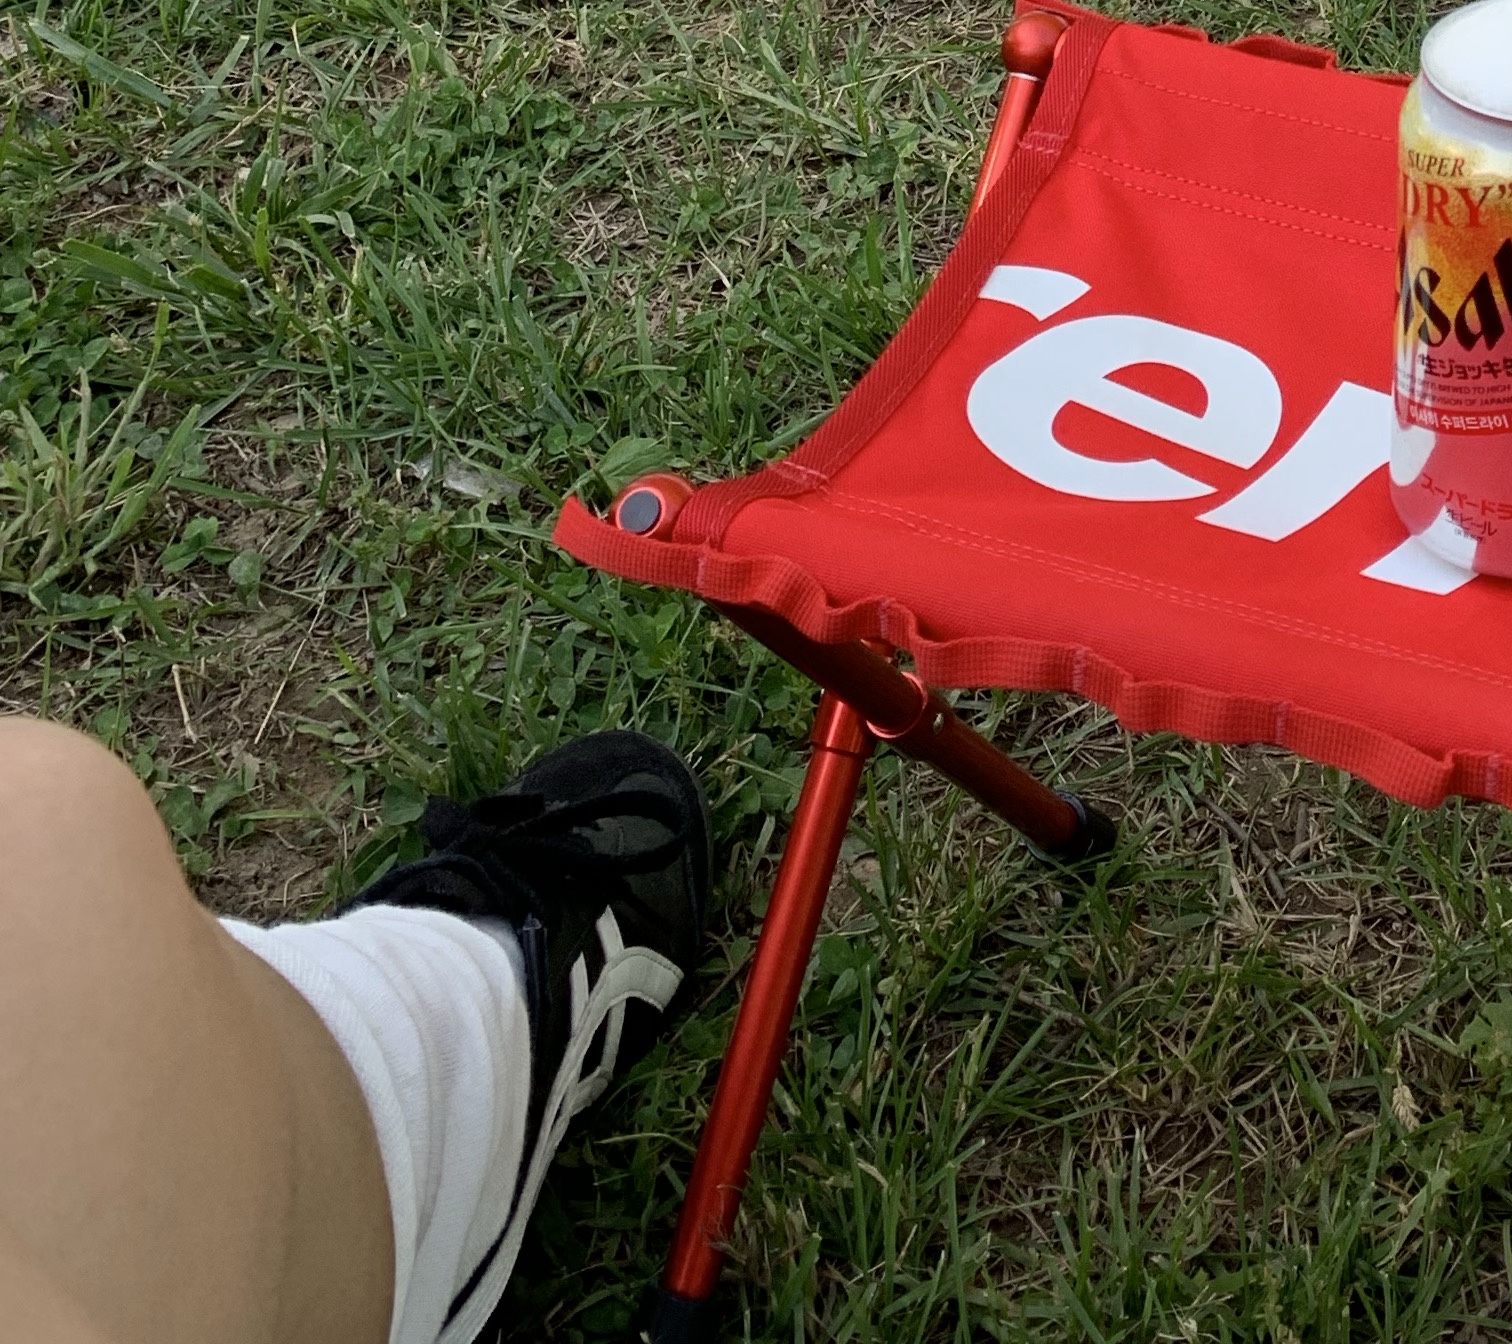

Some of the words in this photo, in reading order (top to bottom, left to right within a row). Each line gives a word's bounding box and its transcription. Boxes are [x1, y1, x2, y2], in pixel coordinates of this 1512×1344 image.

[1408, 149, 1466, 177] SUPER
[1472, 386, 1485, 395] TO
[1441, 413, 1509, 430] 수퍼드라이
